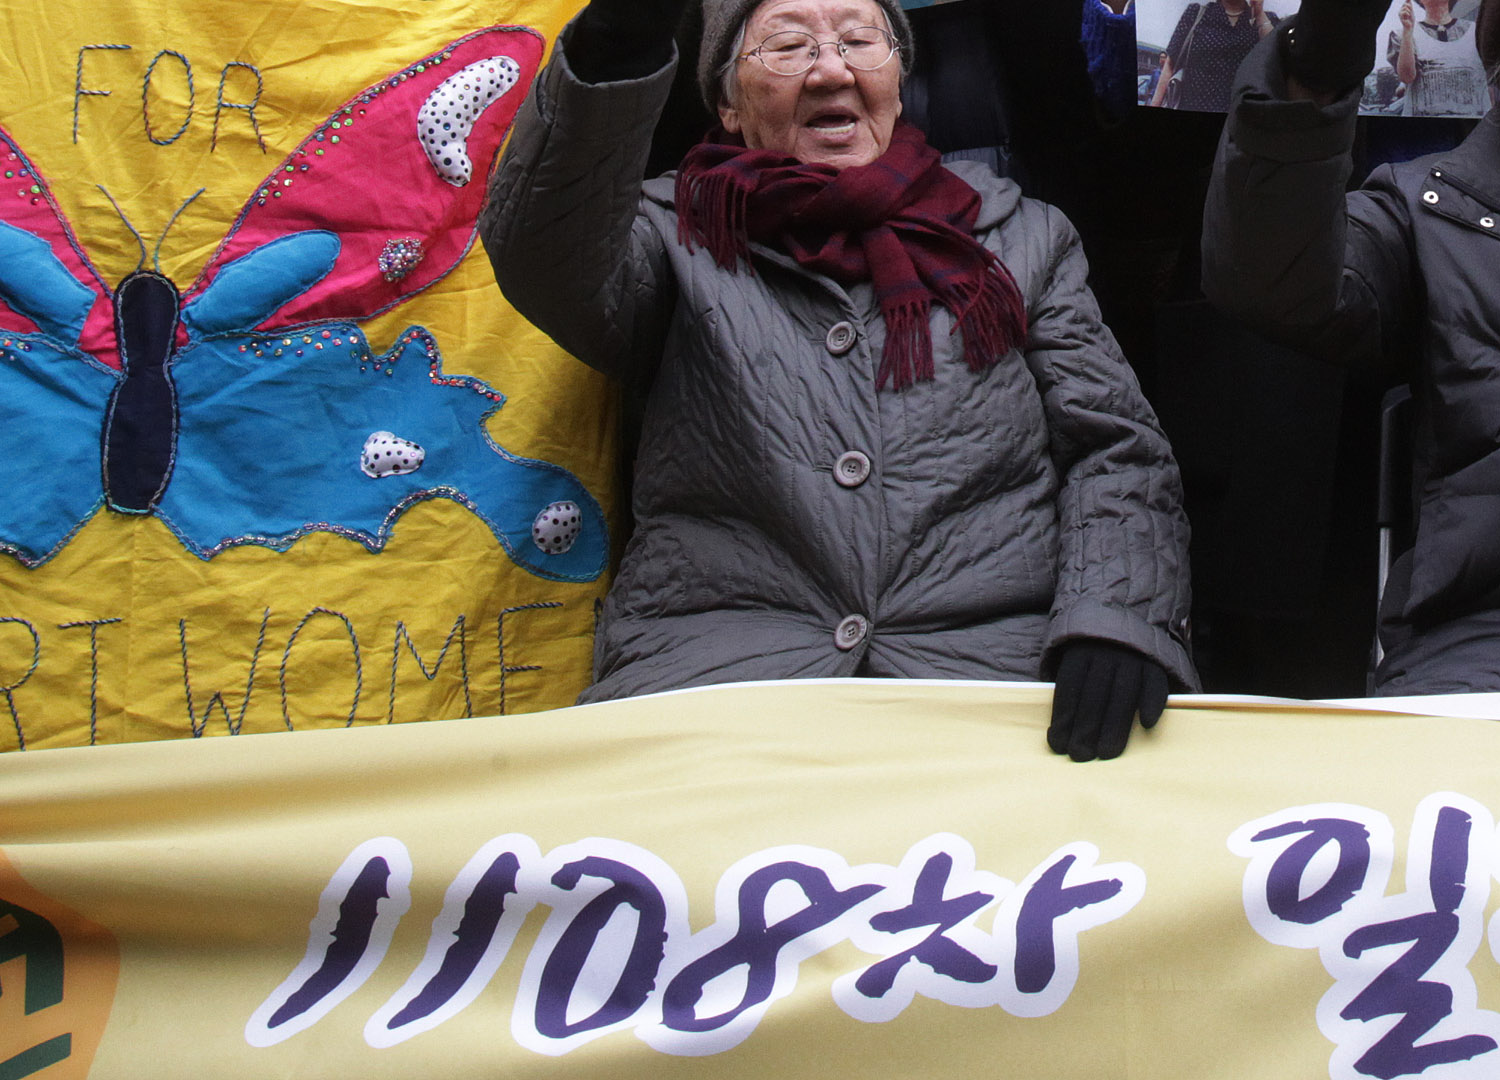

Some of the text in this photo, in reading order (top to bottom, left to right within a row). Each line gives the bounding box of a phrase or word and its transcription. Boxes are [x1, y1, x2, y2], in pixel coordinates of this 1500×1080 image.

[72, 43, 267, 155] FOR
[179, 598, 603, 739] WOME
[266, 851, 1125, 1039] 1108차
